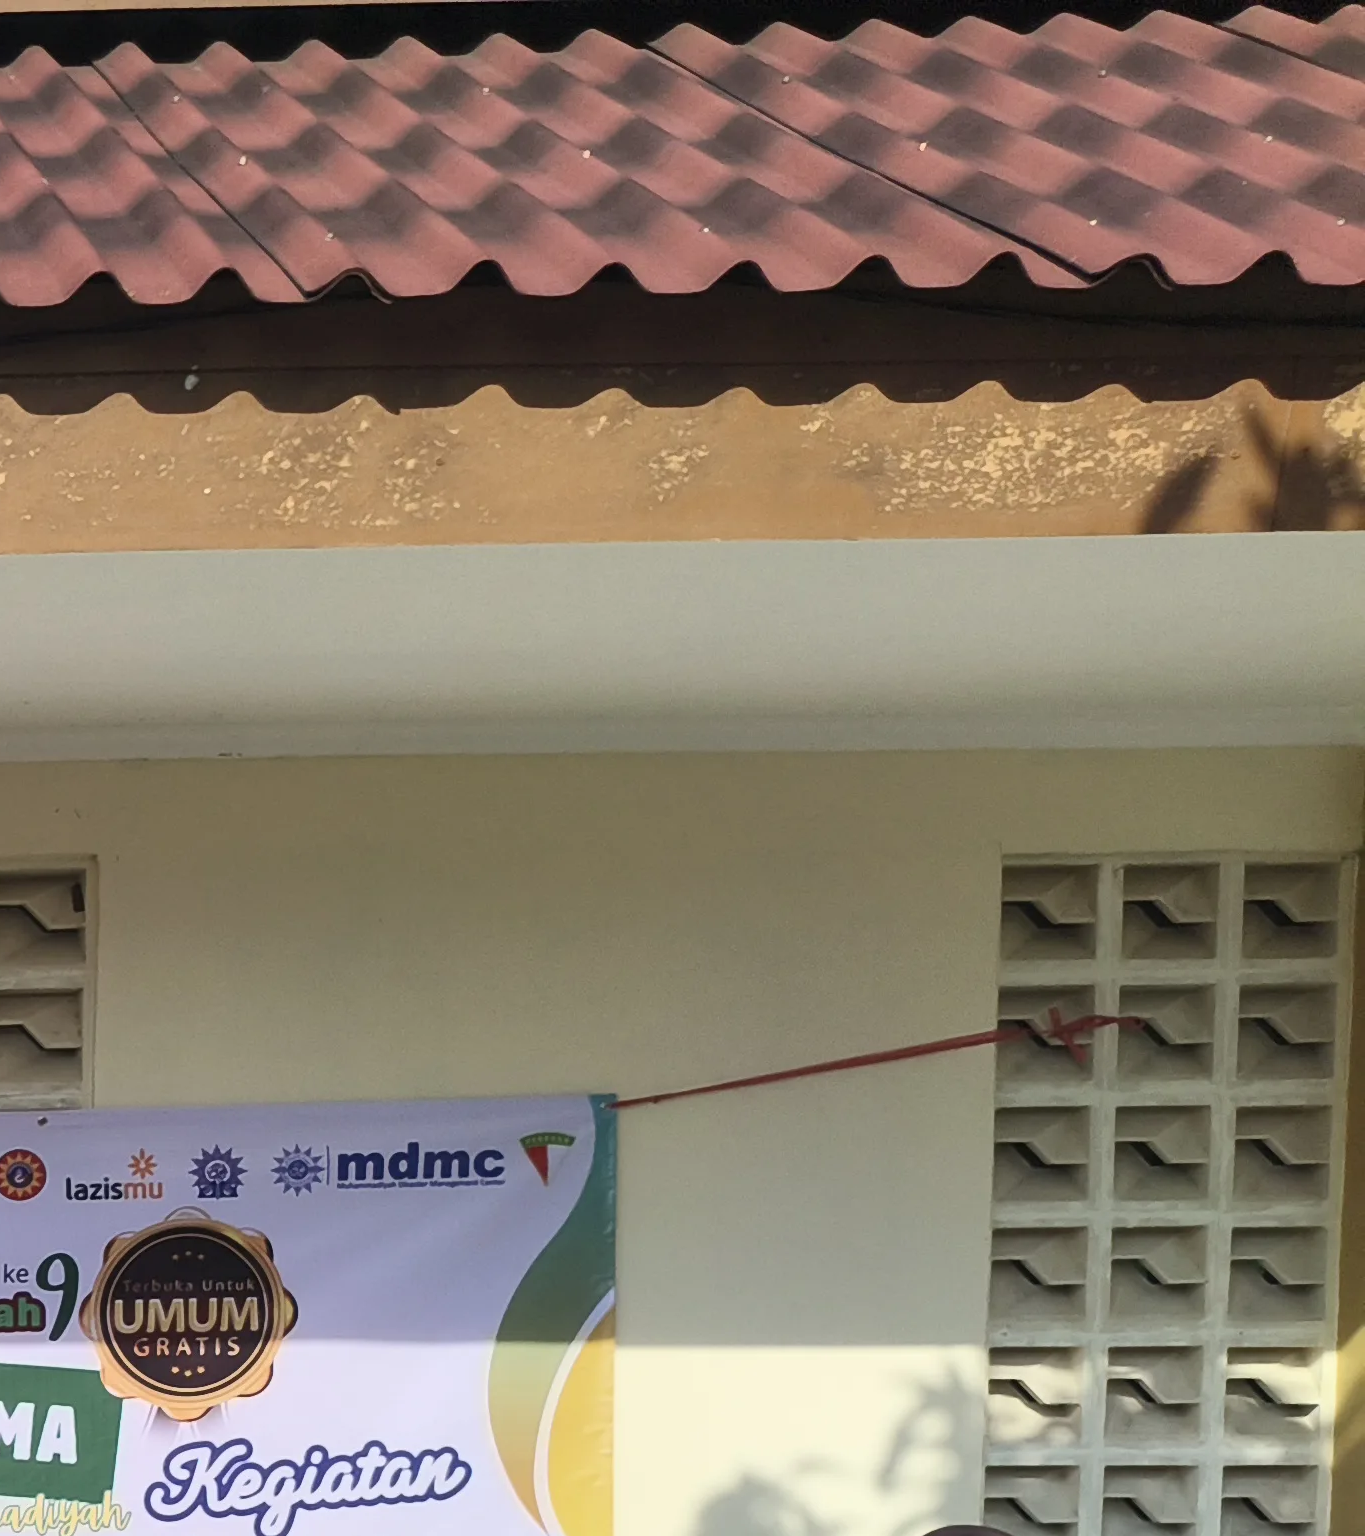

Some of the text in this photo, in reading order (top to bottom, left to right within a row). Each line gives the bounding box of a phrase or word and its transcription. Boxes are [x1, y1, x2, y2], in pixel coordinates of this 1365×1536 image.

[337, 1142, 506, 1181] mdmc
[65, 1177, 164, 1201] lazismu
[3, 1253, 80, 1341] ke 9
[122, 1278, 256, 1292] Terbuka Untuk
[113, 1297, 259, 1334] UMUM
[133, 1336, 241, 1357] GRATIS
